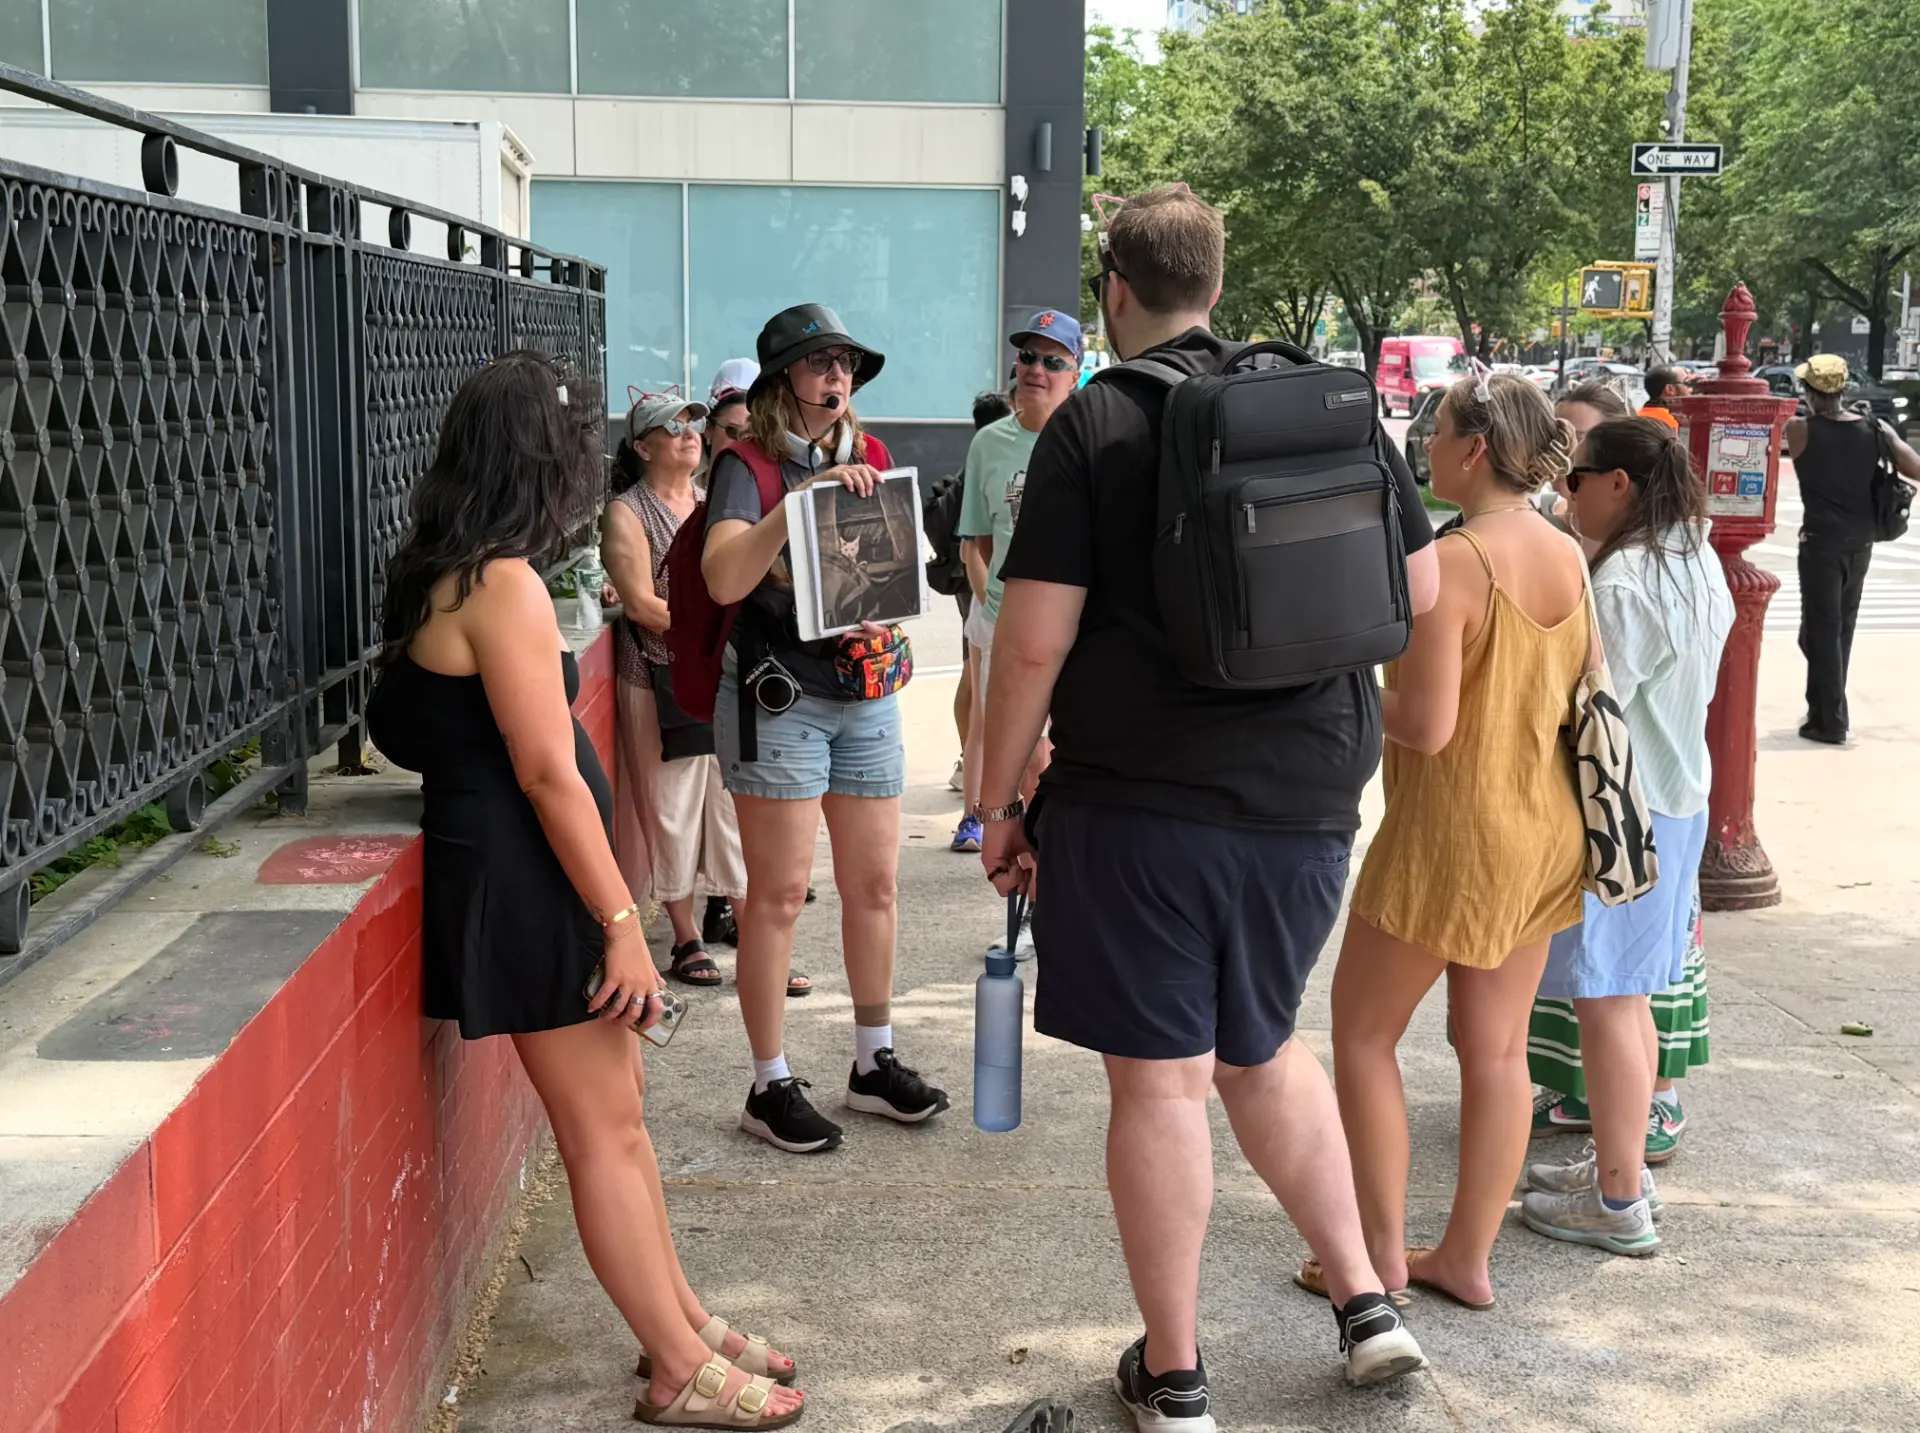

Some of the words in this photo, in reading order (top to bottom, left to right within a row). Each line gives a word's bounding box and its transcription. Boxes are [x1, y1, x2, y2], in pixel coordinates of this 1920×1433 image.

[1646, 153, 1671, 165] ONE
[1683, 154, 1709, 165] WAY
[1741, 474, 1763, 482] Police
